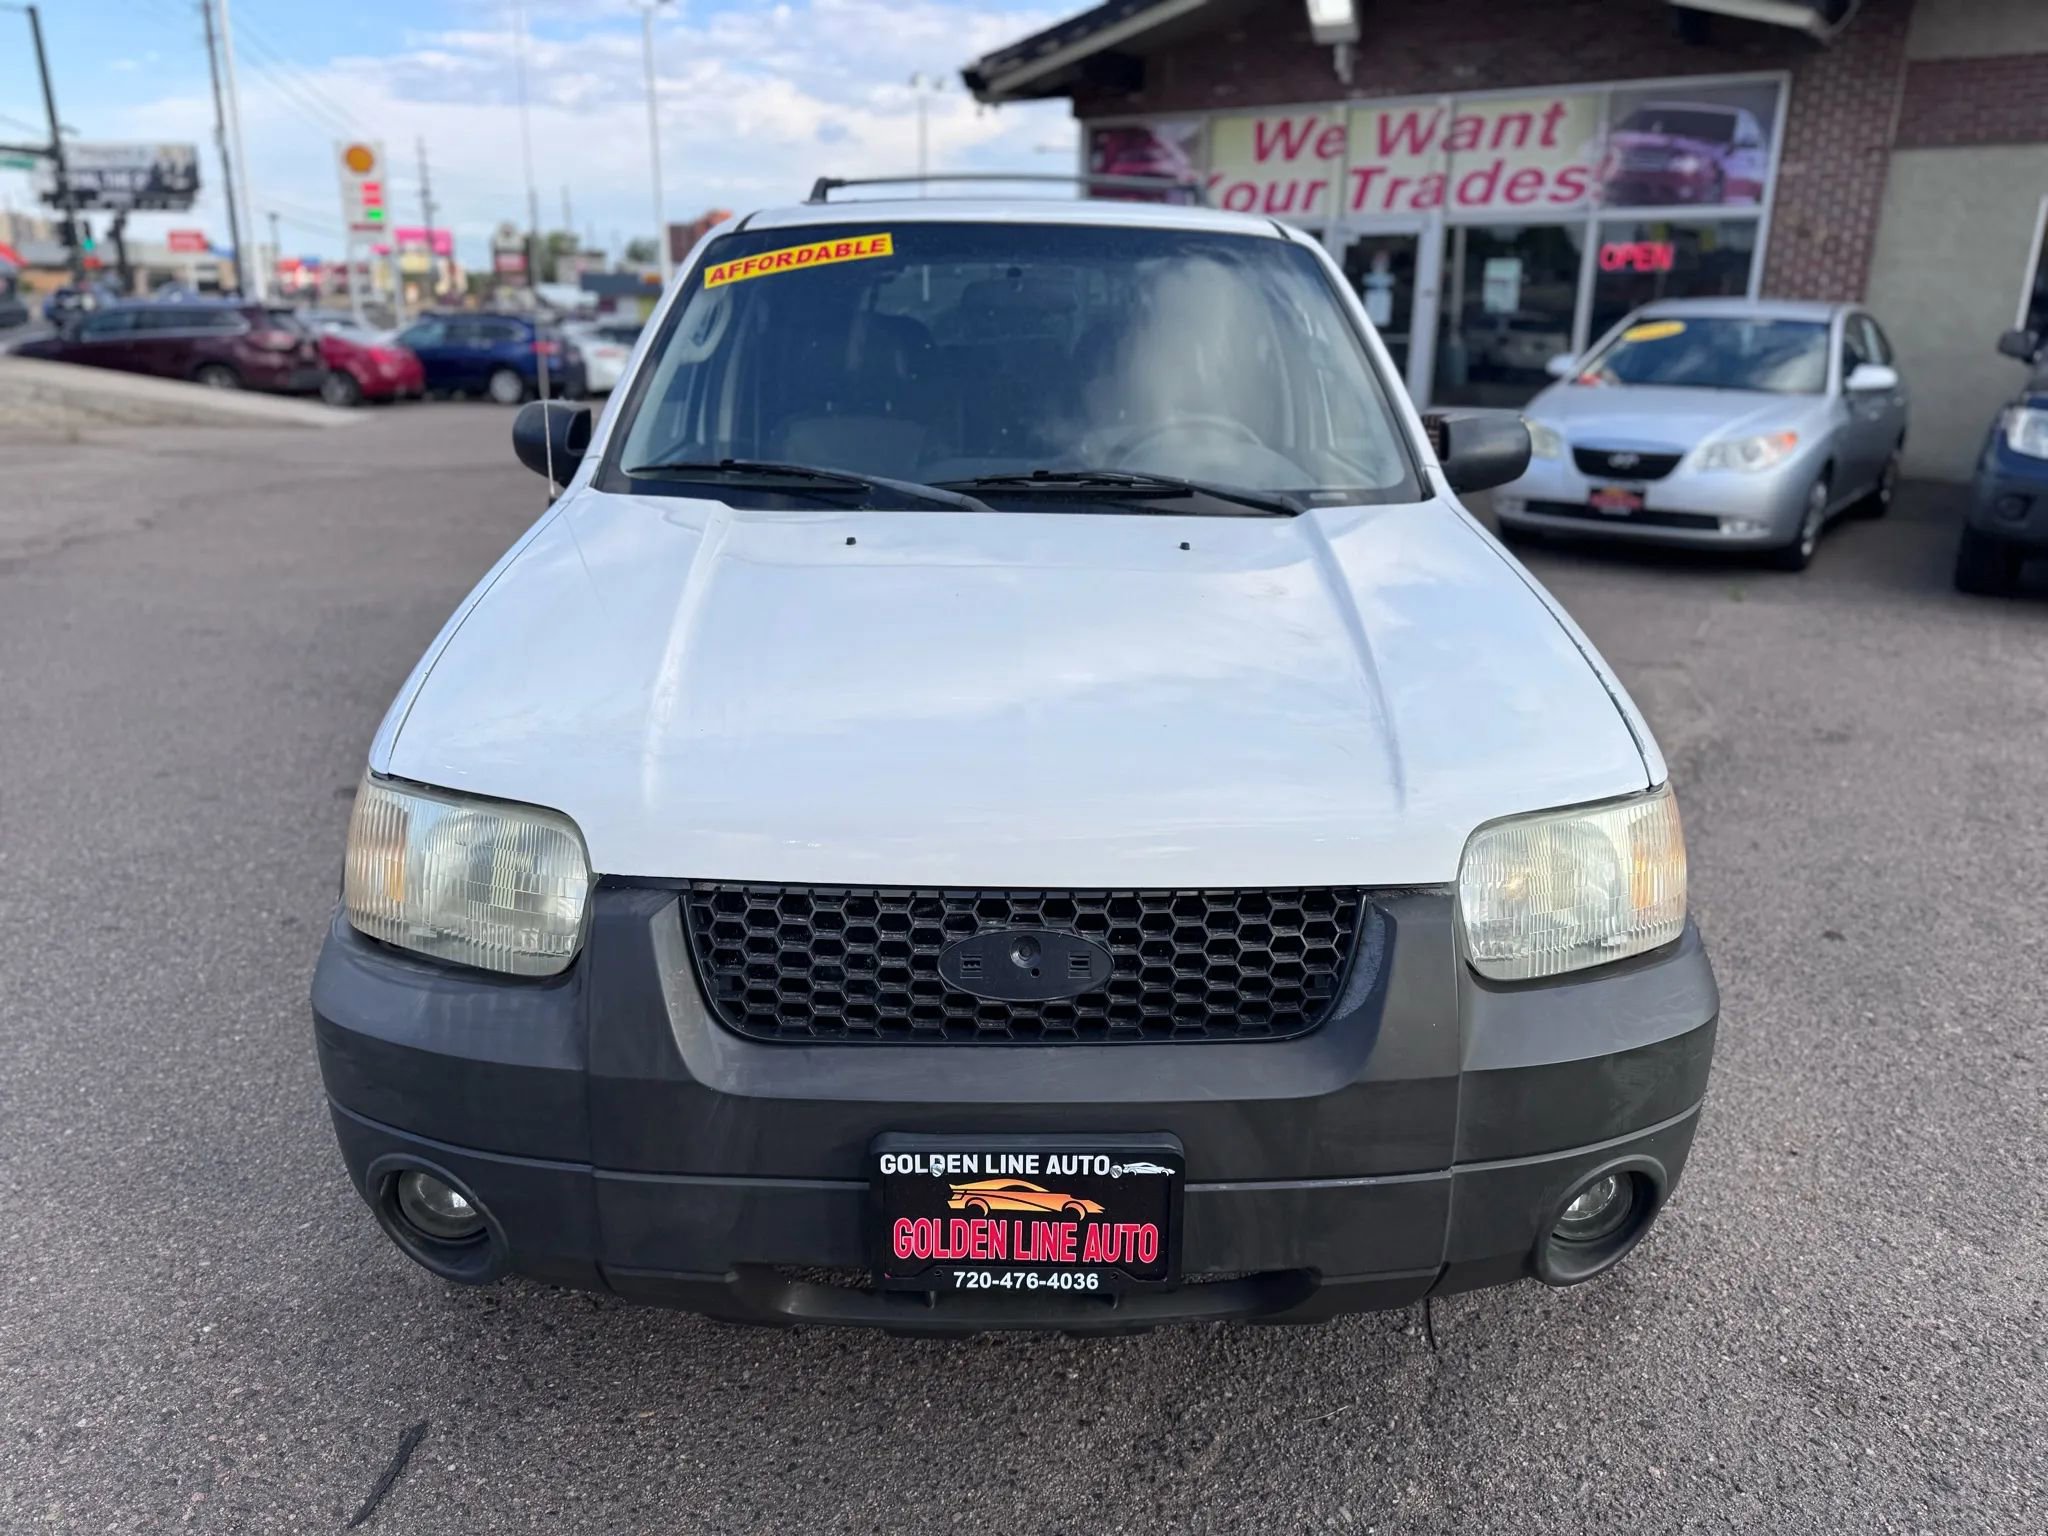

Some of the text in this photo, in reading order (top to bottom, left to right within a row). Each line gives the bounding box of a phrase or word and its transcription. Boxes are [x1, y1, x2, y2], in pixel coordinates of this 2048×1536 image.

[1254, 101, 1567, 165] We Want
[708, 238, 887, 284] AFFORDABLE
[1599, 241, 1674, 272] OPEN
[880, 1153, 1111, 1176] GOLDEN LINE AUTO
[893, 1217, 1159, 1264] GOLDEN LINE AUTO
[953, 1271, 1099, 1290] 720-476-4036
